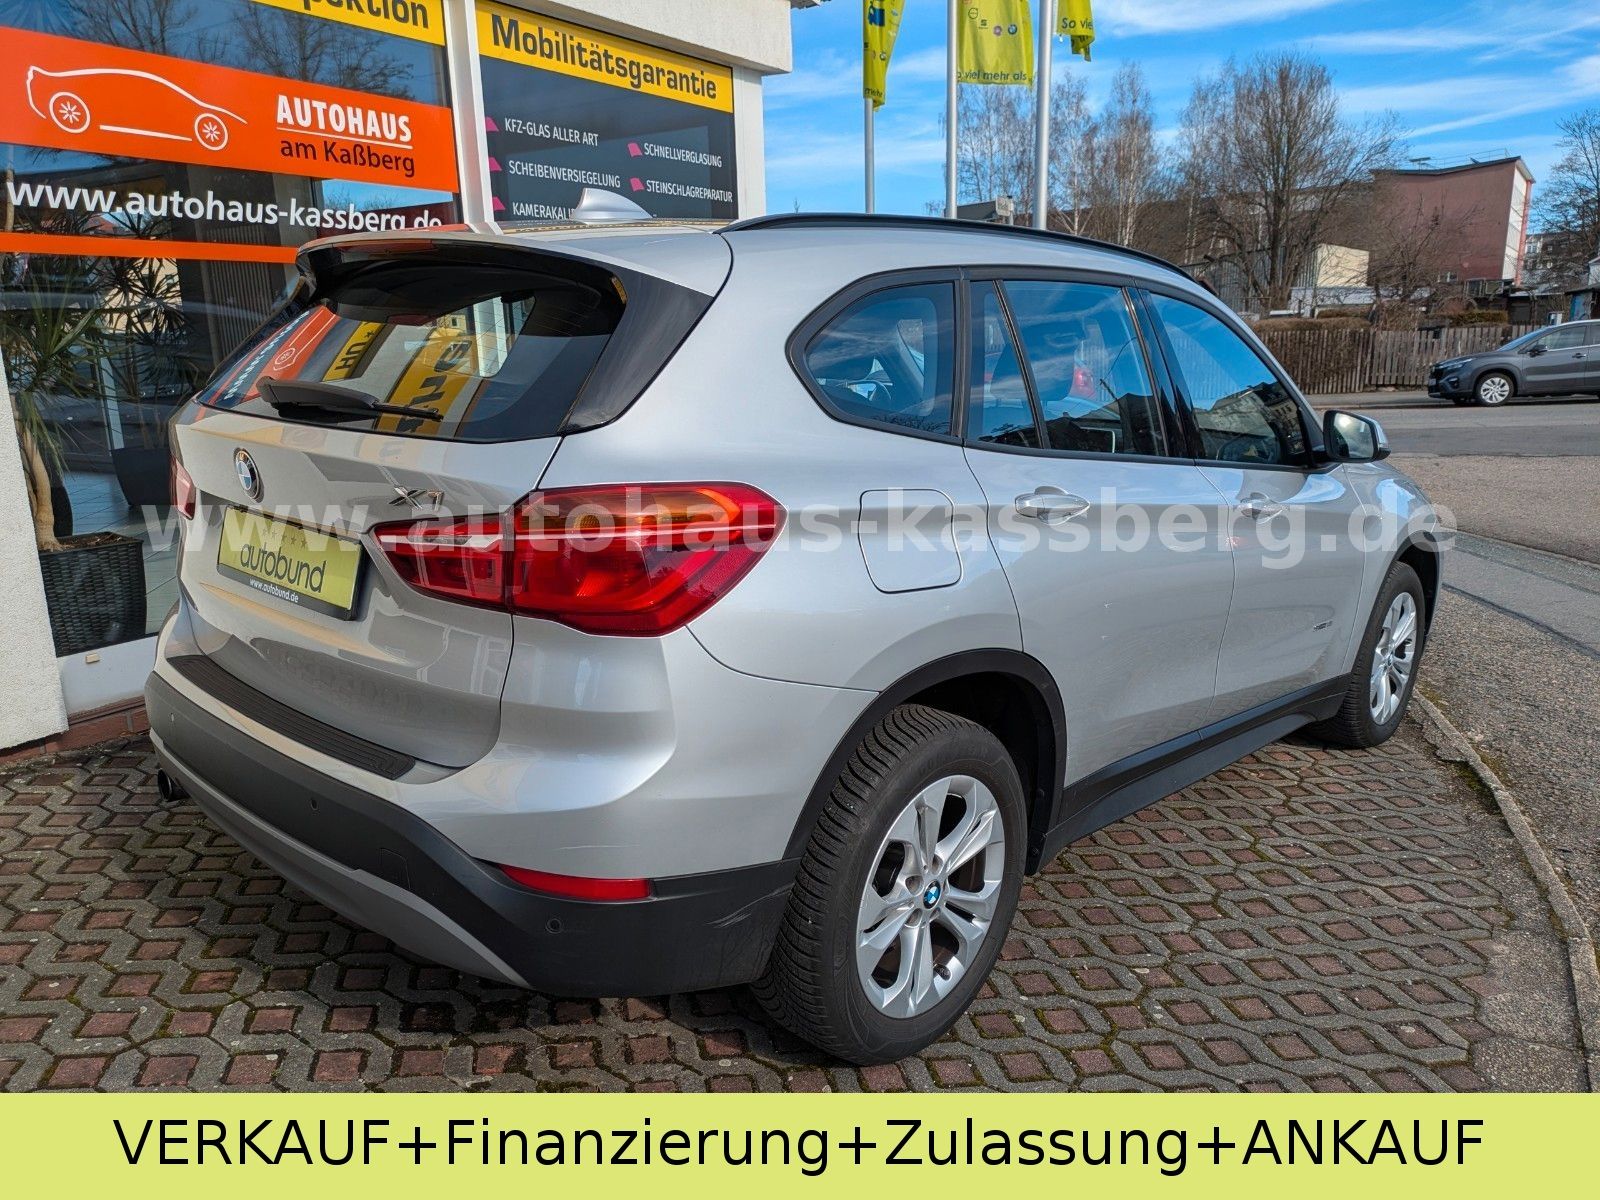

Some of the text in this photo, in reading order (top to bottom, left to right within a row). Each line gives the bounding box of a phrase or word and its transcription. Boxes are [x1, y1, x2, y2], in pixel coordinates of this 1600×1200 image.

[1062, 17, 1093, 30] So vie
[491, 14, 717, 99] Mobilitätsgarantie
[965, 70, 980, 79] viel
[983, 70, 1010, 80] mehr
[1013, 71, 1027, 81] als
[276, 94, 412, 142] AUTOHAUS
[504, 118, 599, 147] KFZ-GLAS ALLER ART
[280, 140, 415, 178] am Kaßberg
[644, 143, 722, 168] SCHNELLVERGLASUNG
[508, 160, 621, 188] SCHEIBENVERSIEGELUNG
[646, 180, 733, 203] STEINSCHLAGREPARATUR
[512, 201, 576, 221] KAMERAKALI
[240, 541, 327, 594] autobund
[250, 579, 299, 603] www.autobund.de
